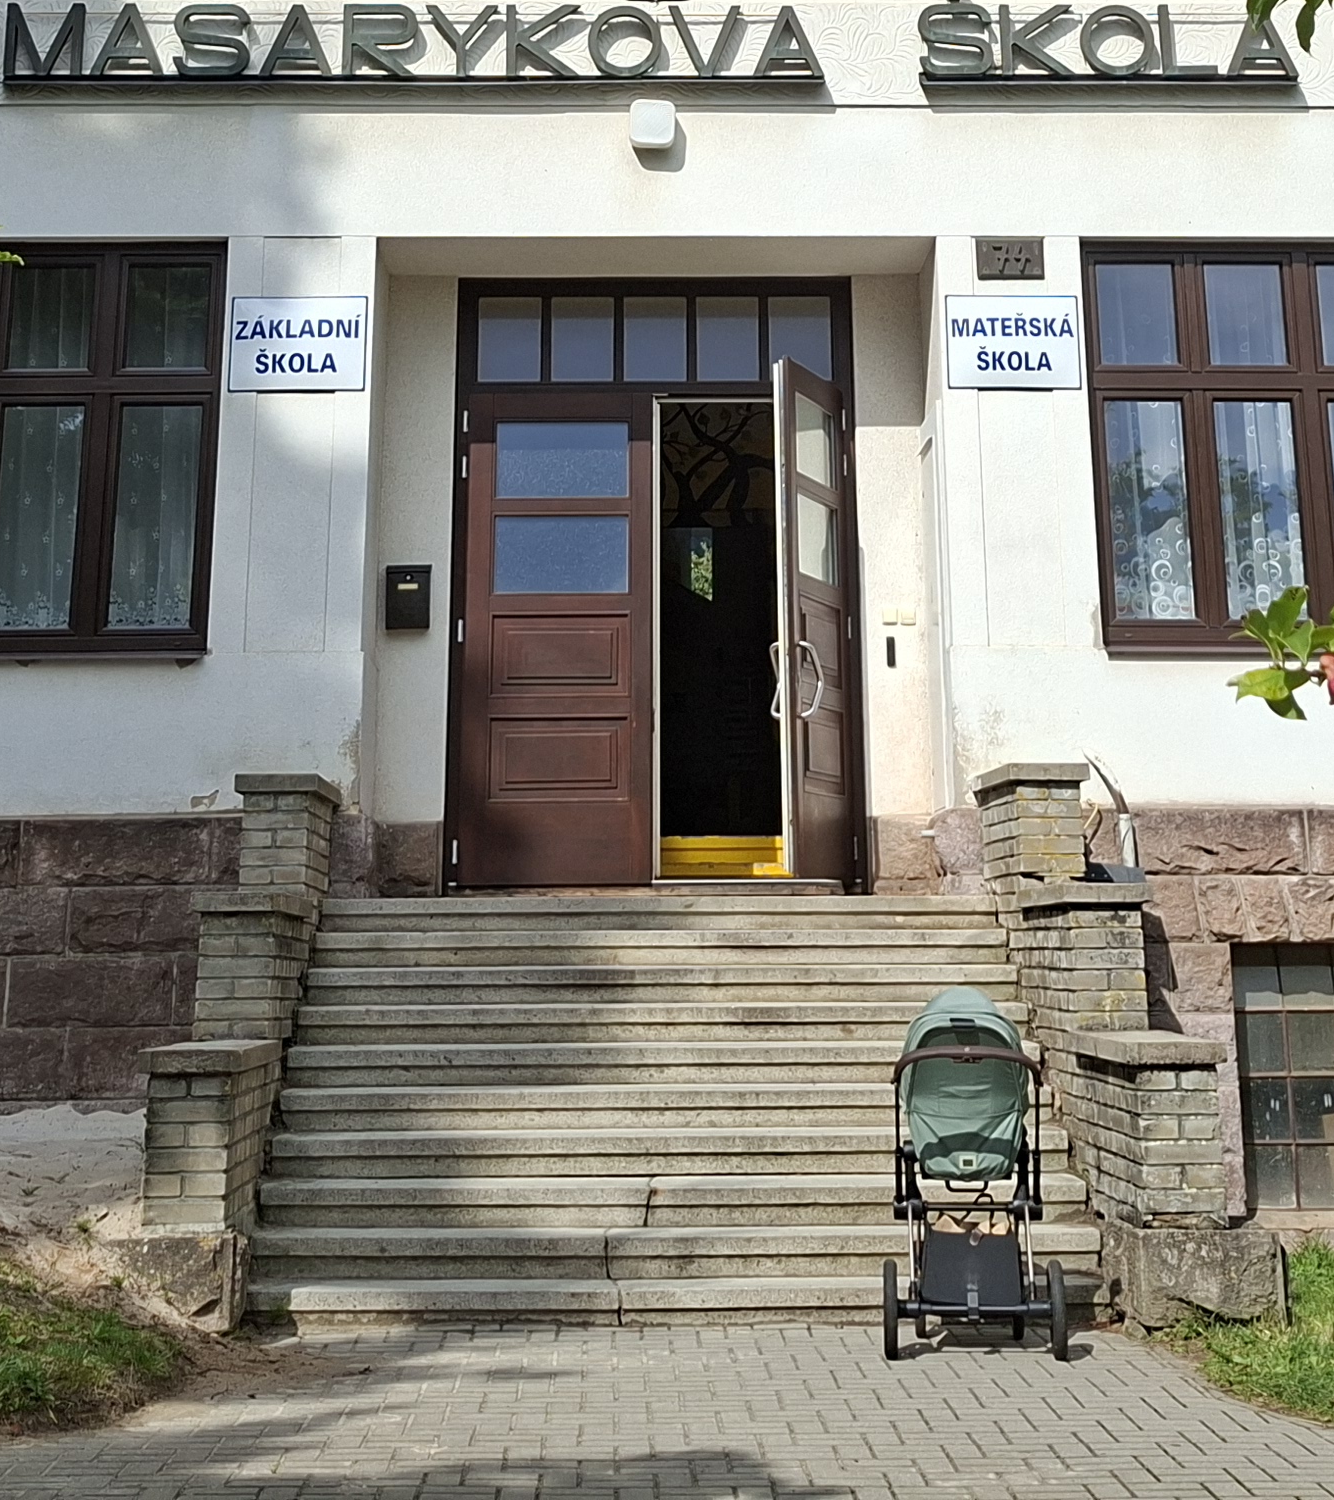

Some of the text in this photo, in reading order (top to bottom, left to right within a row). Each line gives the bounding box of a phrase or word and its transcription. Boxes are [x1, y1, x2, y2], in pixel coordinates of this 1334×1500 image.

[3, 1, 823, 77] MASARYKOVA
[234, 314, 362, 341] ZÁKLADNÍ
[951, 312, 1074, 338] MATEŘSKÁ
[254, 348, 338, 374] ŠKOLA
[976, 346, 1053, 372] ŠKOLA
